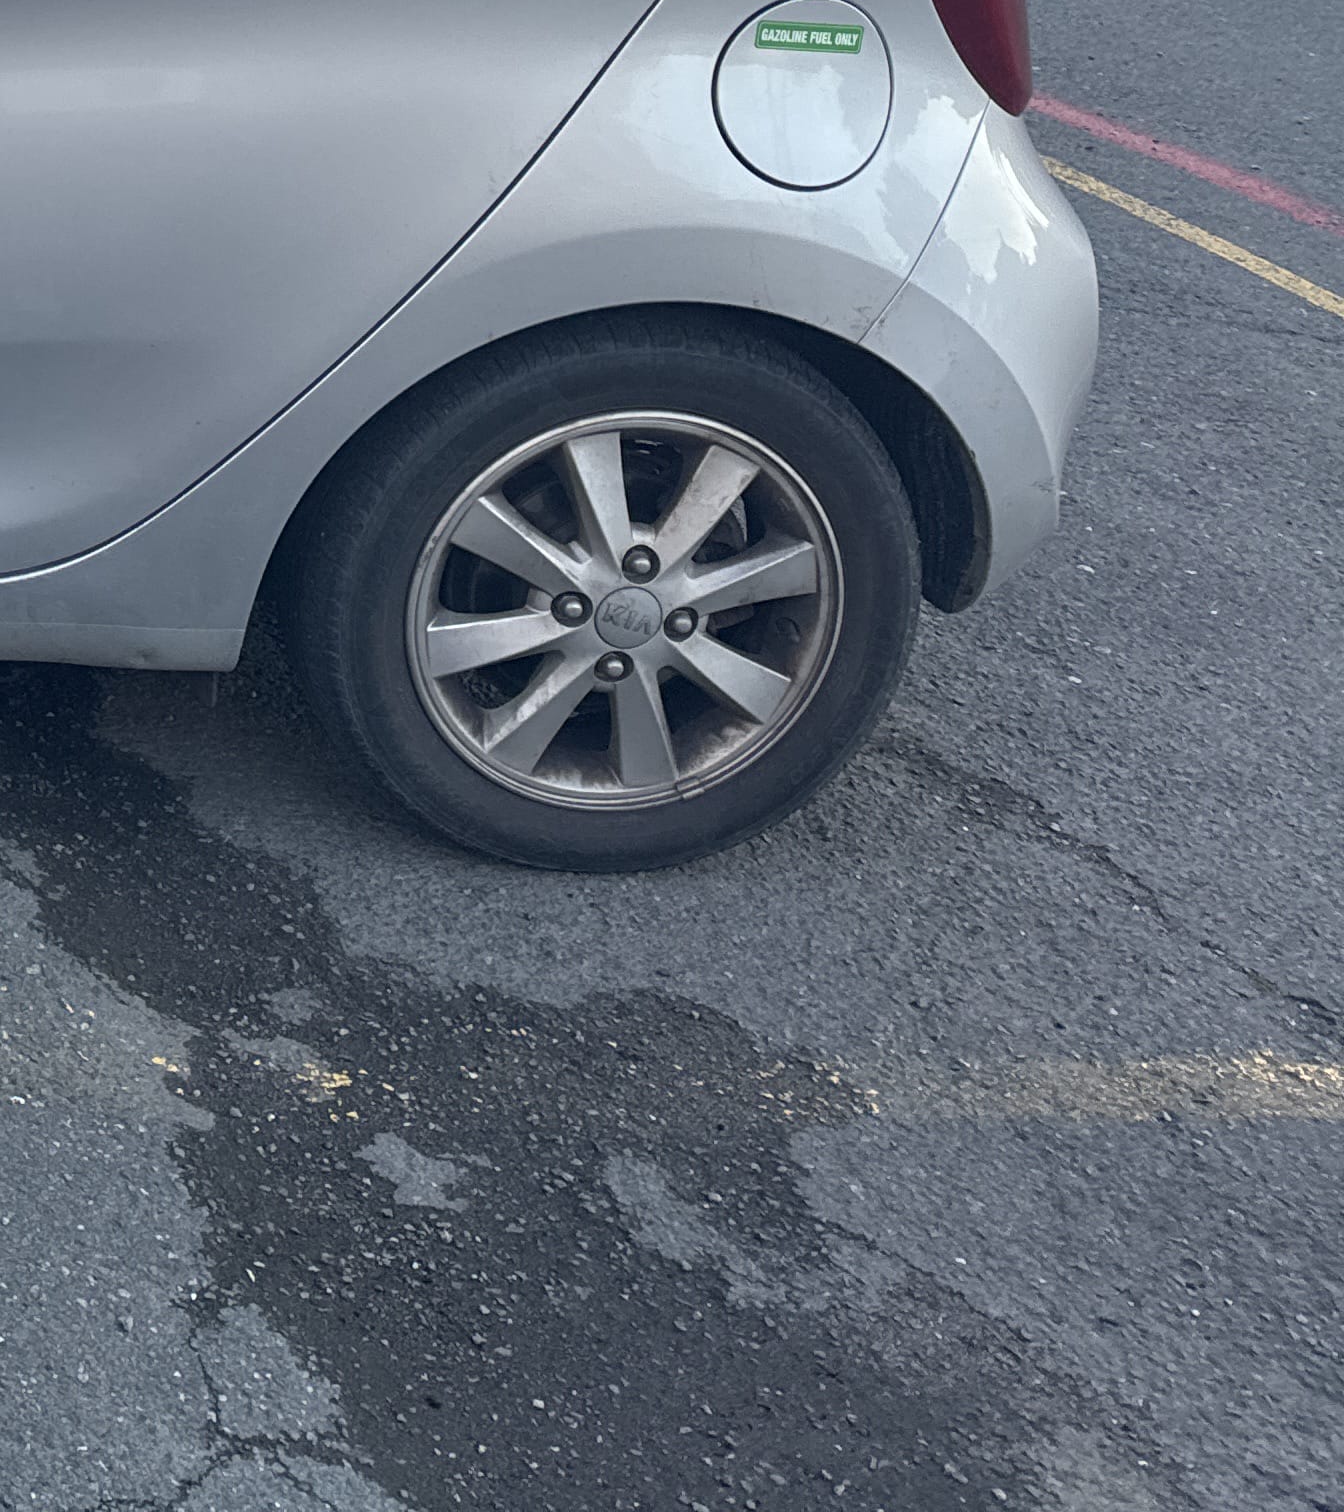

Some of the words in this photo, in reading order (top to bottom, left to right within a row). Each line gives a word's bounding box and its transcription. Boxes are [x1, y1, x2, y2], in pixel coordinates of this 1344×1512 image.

[760, 28, 808, 44] GAZOLINE
[809, 31, 833, 45] FUEL
[834, 32, 859, 46] ONLY
